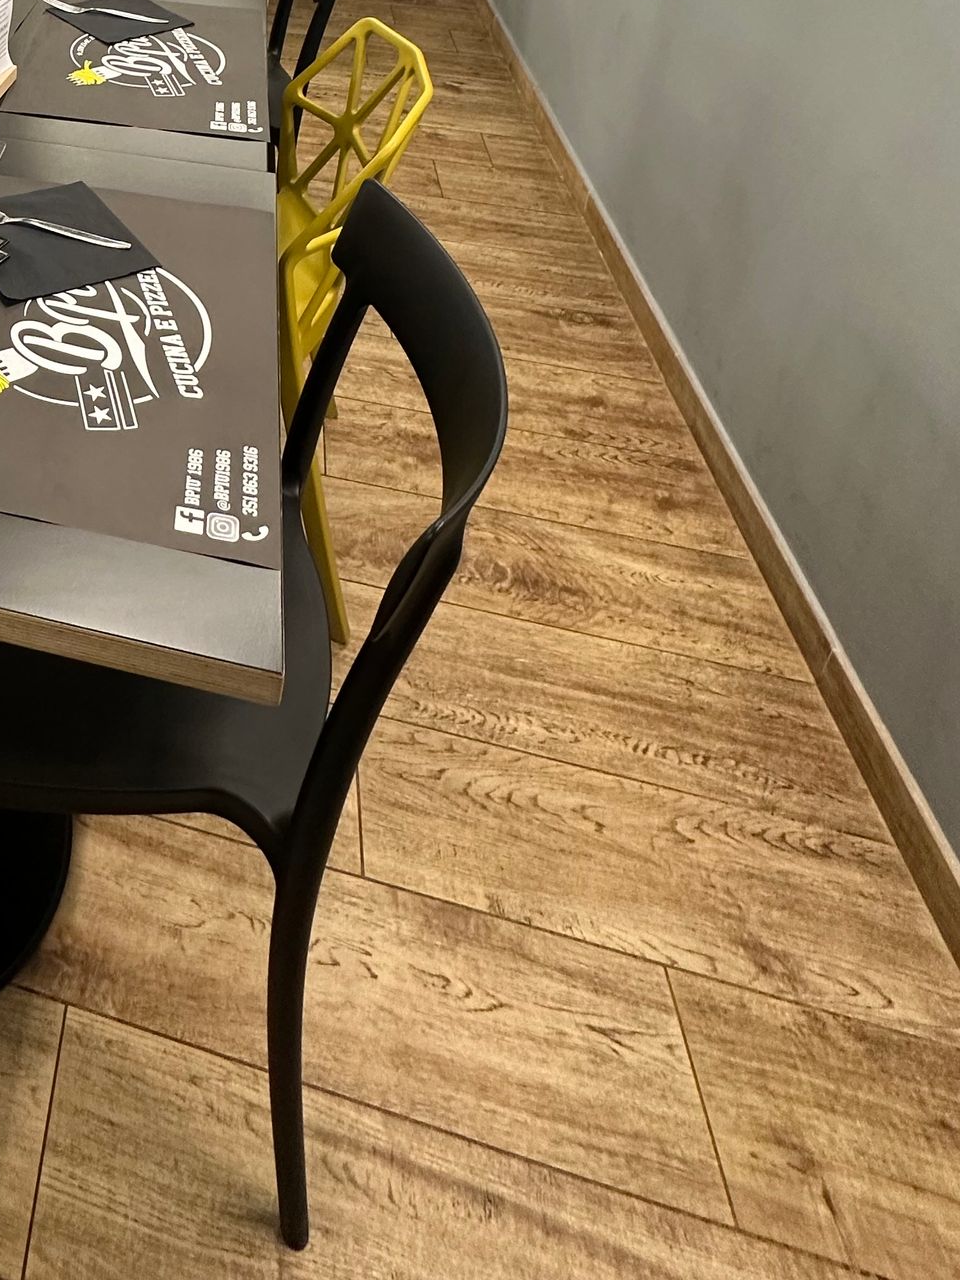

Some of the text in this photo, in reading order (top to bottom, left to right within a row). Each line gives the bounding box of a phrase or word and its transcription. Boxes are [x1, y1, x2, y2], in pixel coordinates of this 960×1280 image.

[154, 318, 178, 331] E
[160, 333, 204, 400] CUCINA
[187, 448, 204, 476] 1986
[242, 445, 259, 517] 351 863 9316
